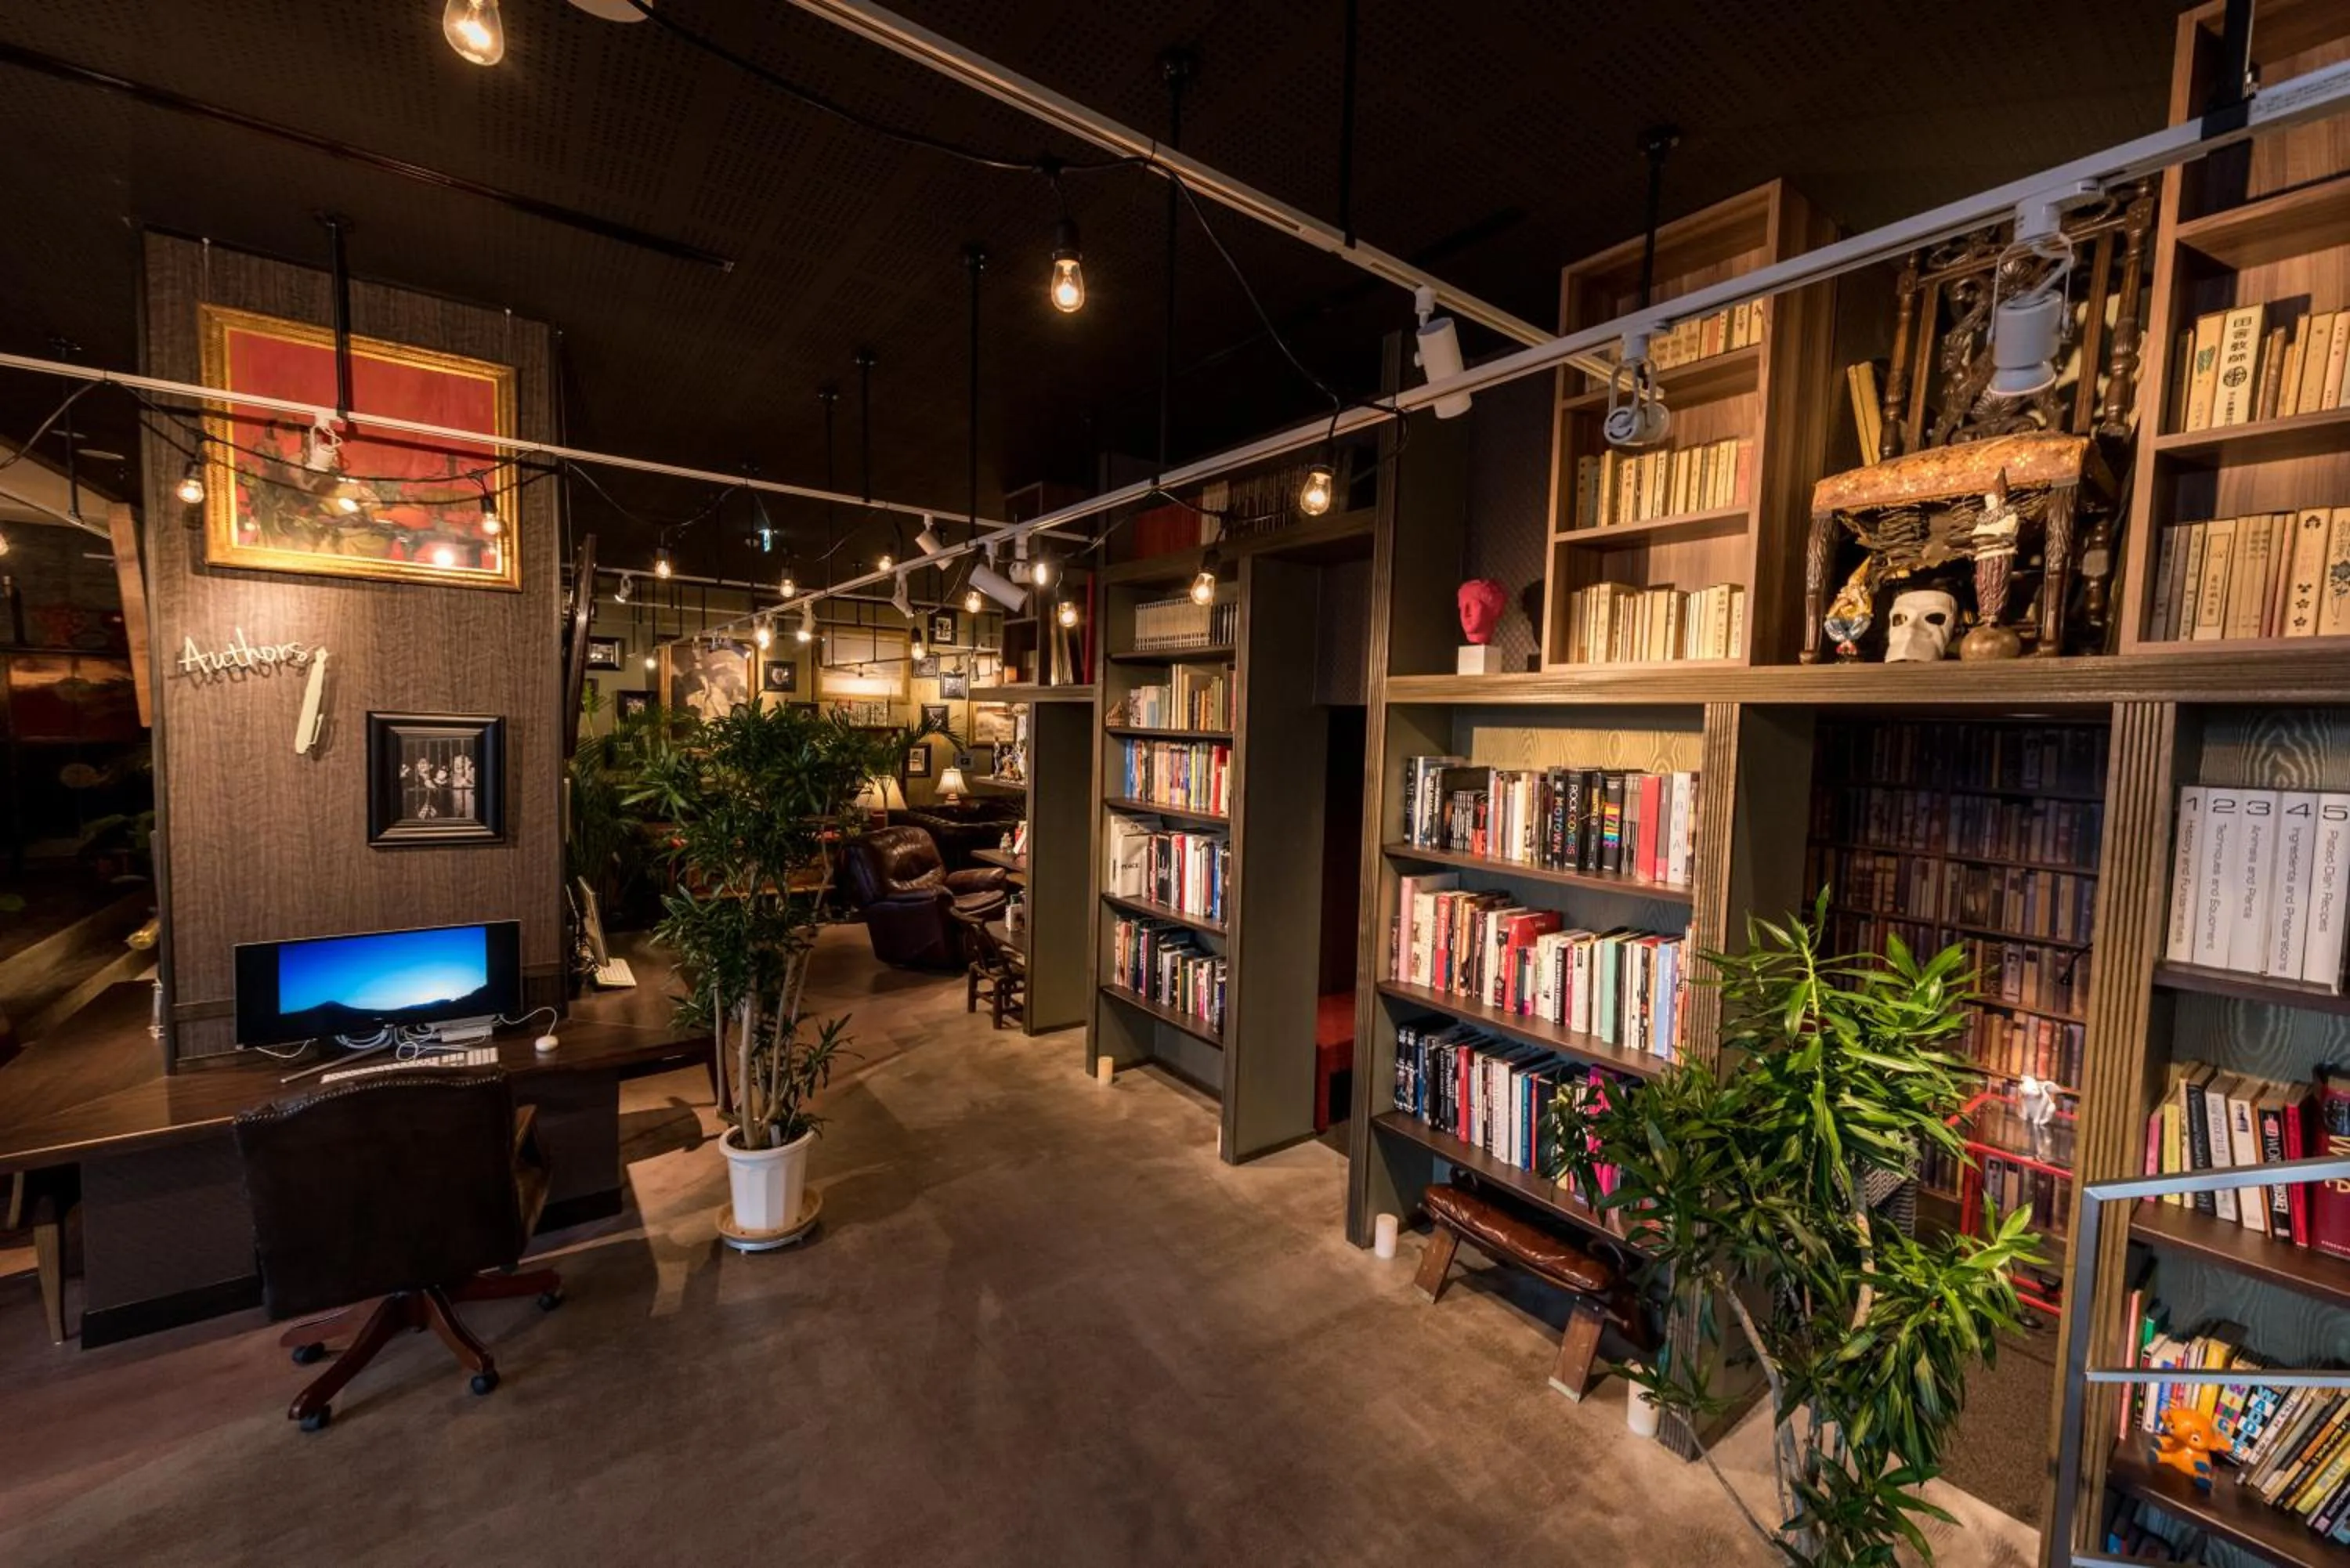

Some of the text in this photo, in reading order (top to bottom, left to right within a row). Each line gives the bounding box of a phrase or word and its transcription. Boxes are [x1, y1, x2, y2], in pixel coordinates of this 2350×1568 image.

[178, 627, 309, 674] Authors
[1553, 797, 1564, 854] MOTOWN
[1566, 784, 1579, 855] ROCK COVERS
[2323, 804, 2349, 821] 5
[2175, 797, 2198, 944] 1 History and Fundamentals
[2206, 798, 2236, 950] 2 Techniques and Equipment
[2243, 800, 2272, 919] 3 Animals and Plants
[2279, 802, 2312, 973] 4 Ingredients and Preparations
[2319, 892, 2334, 933] Recipes
